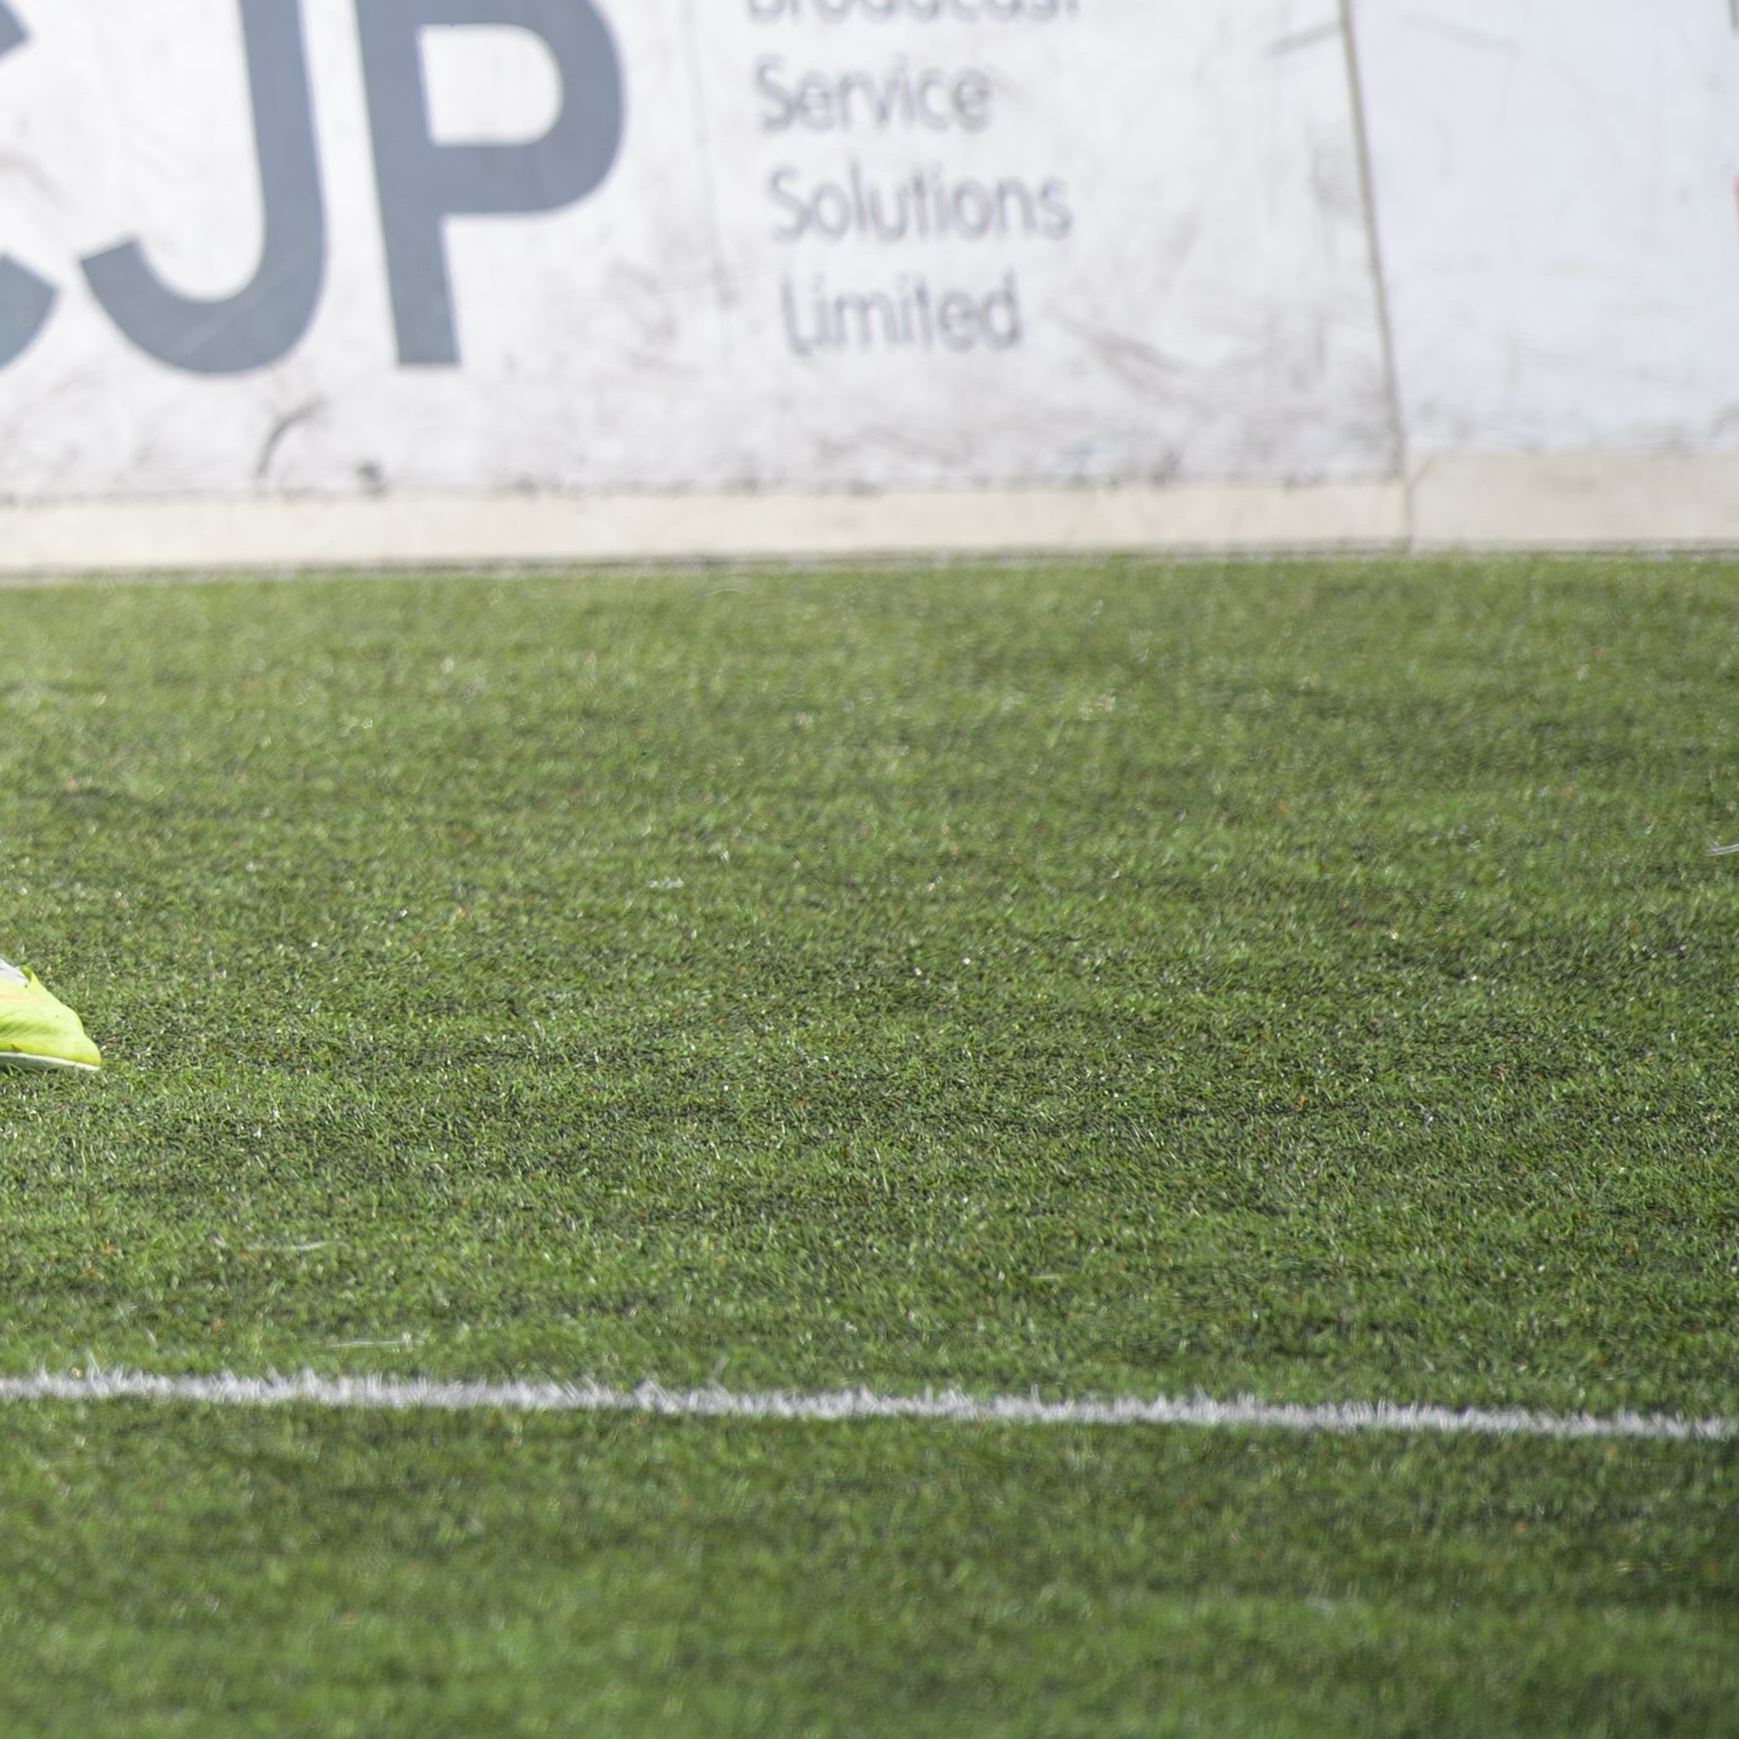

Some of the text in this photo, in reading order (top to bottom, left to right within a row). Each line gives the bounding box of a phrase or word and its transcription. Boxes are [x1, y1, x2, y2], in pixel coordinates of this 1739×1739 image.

[755, 55, 994, 133] Service
[769, 157, 1075, 244] Solutions
[779, 269, 1024, 357] Limited
